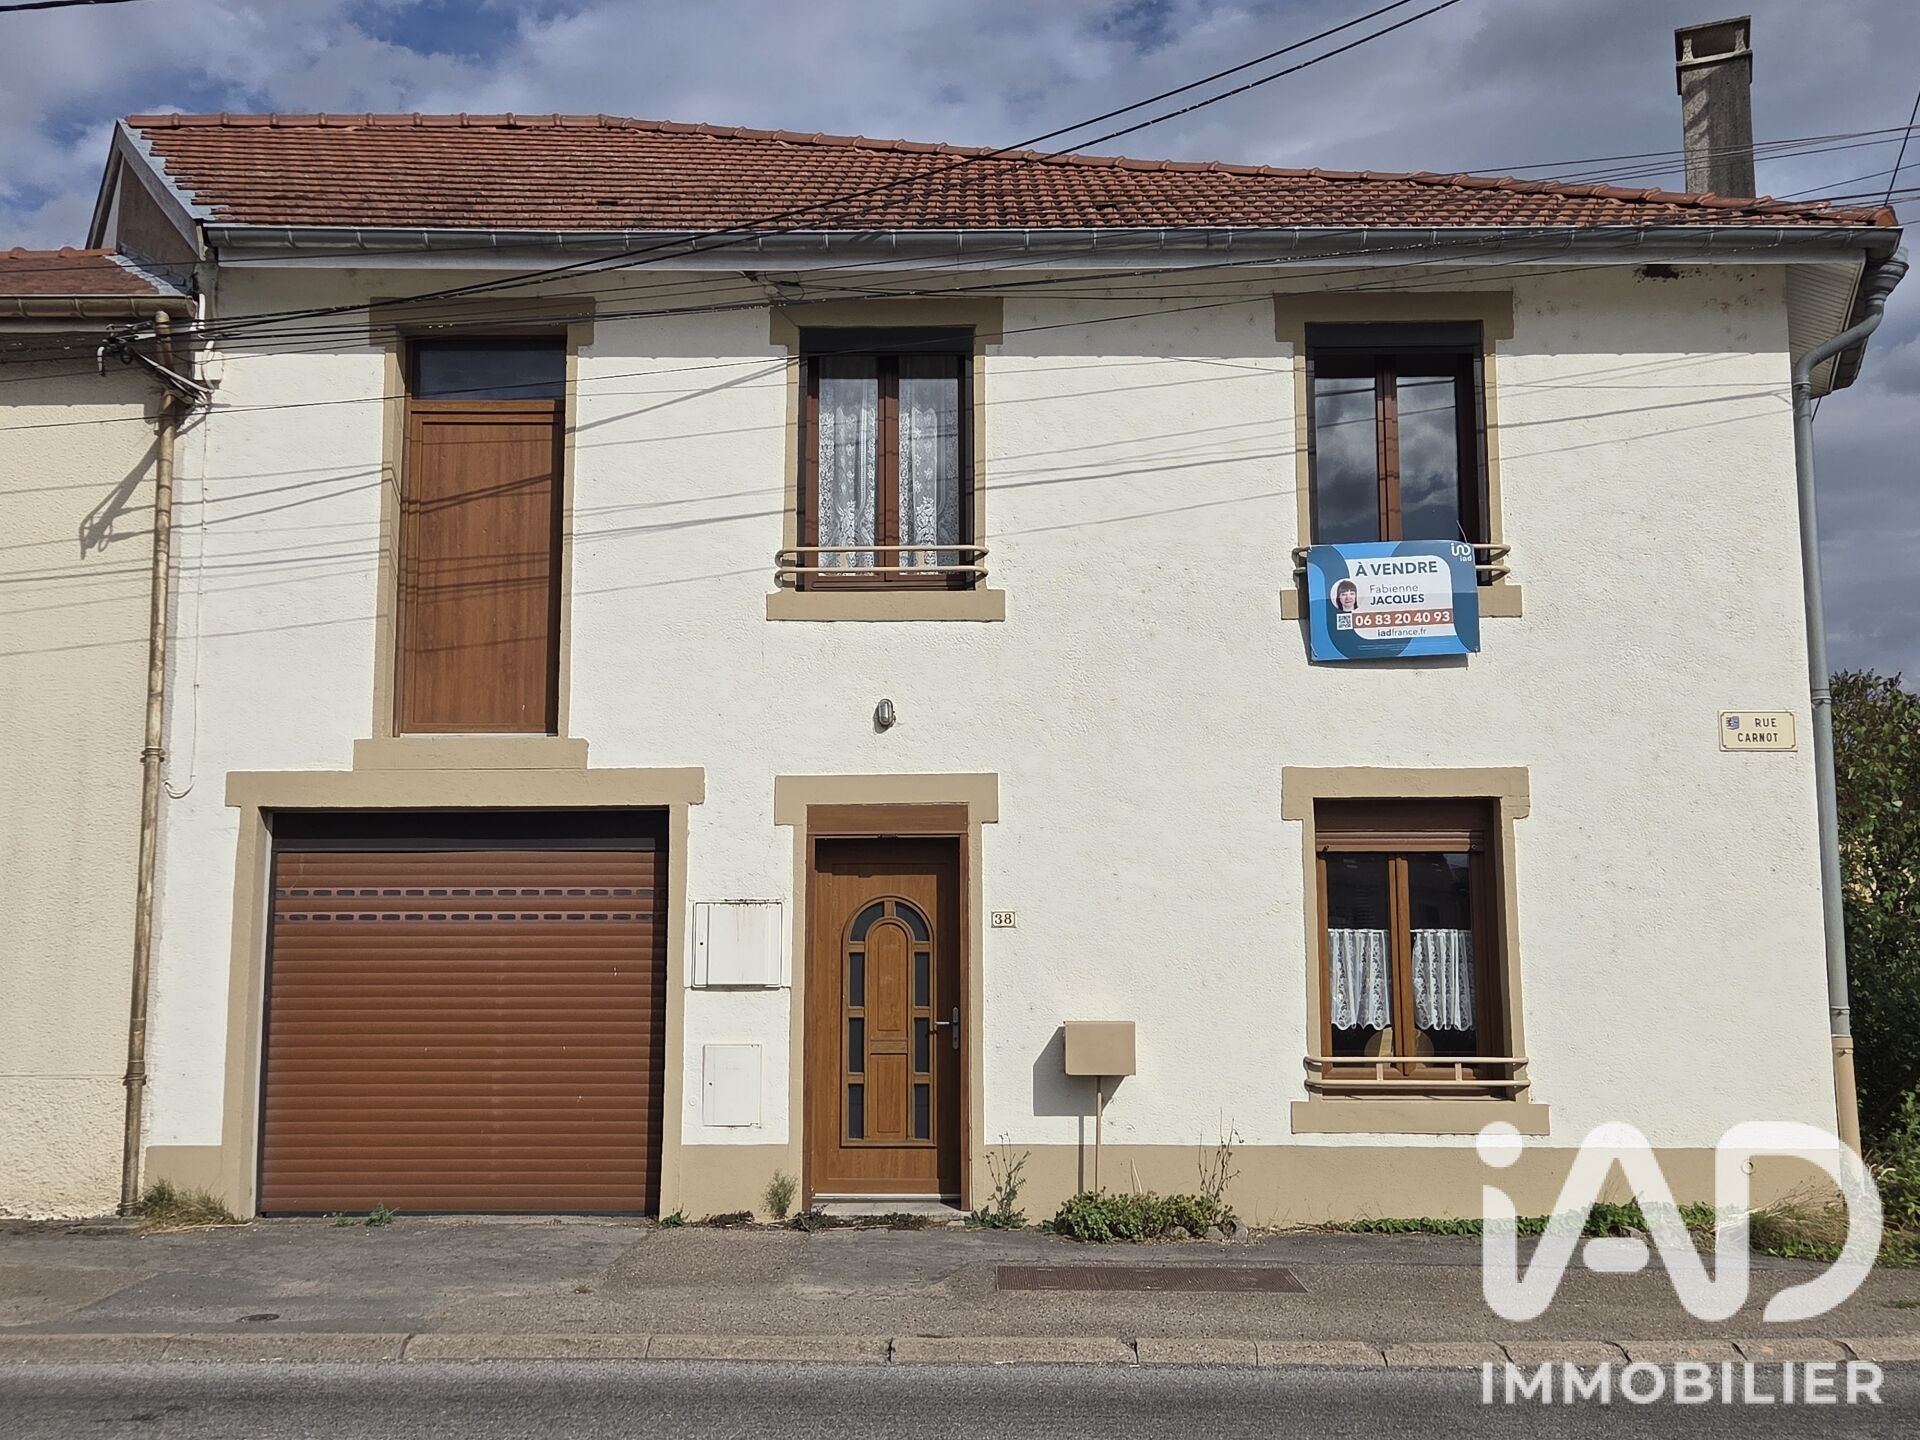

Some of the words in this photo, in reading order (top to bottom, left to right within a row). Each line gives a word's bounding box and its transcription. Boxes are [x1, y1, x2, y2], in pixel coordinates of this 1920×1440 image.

[1355, 562, 1368, 577] À
[1371, 561, 1438, 576] VENDRE
[1369, 584, 1419, 594] Fabienne
[1370, 594, 1425, 606] JACQUES
[1355, 615, 1372, 626] 06
[1375, 614, 1391, 625] 83
[1394, 613, 1411, 624] 20
[1414, 612, 1430, 623] 40
[1433, 611, 1450, 622] 93
[1377, 627, 1427, 637] iadfrance.fr
[1755, 718, 1777, 727] RUE
[1737, 733, 1778, 742] CARNOT
[994, 913, 1012, 925] 38
